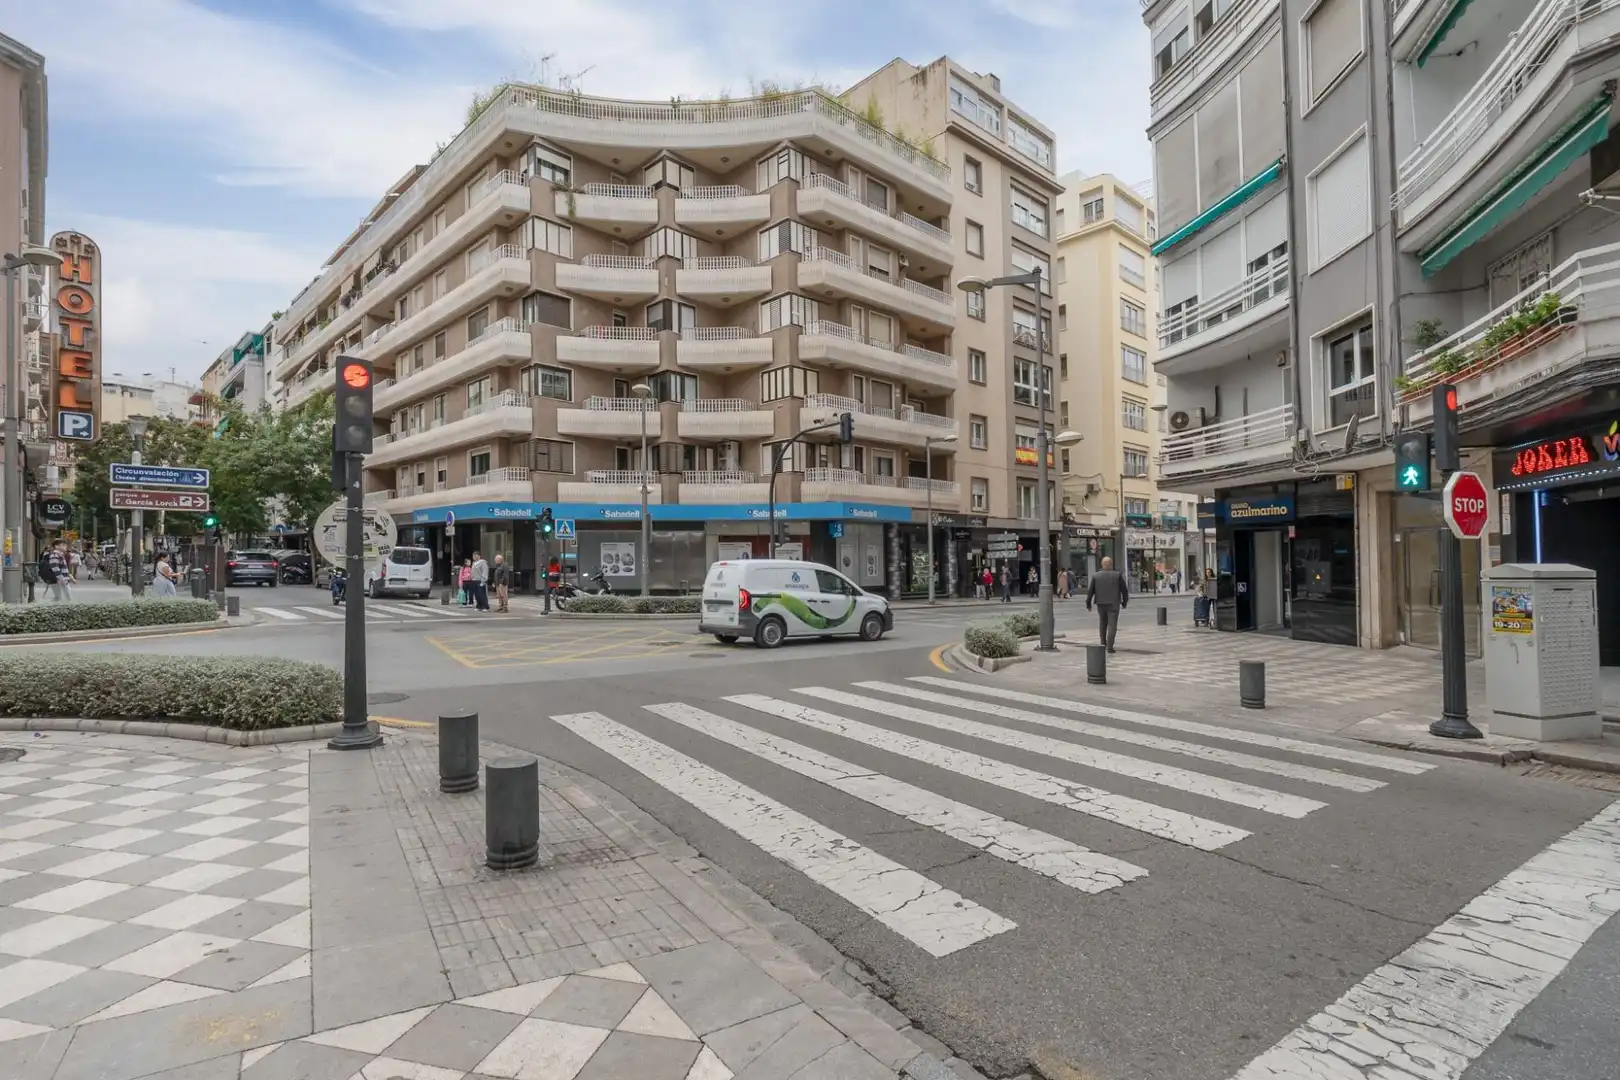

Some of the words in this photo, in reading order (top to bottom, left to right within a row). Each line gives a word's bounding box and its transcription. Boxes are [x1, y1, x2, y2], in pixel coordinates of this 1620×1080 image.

[57, 250, 94, 410] HOTEL
[64, 415, 87, 436] P
[1511, 436, 1589, 476] JOKER
[115, 467, 179, 477] Circunvalación
[125, 498, 153, 506] García
[1454, 497, 1484, 513] STOP
[494, 508, 532, 517] Sabadell
[605, 509, 640, 518] Sabadell
[853, 509, 878, 518] Sabadell
[1231, 504, 1287, 518] azulmarino
